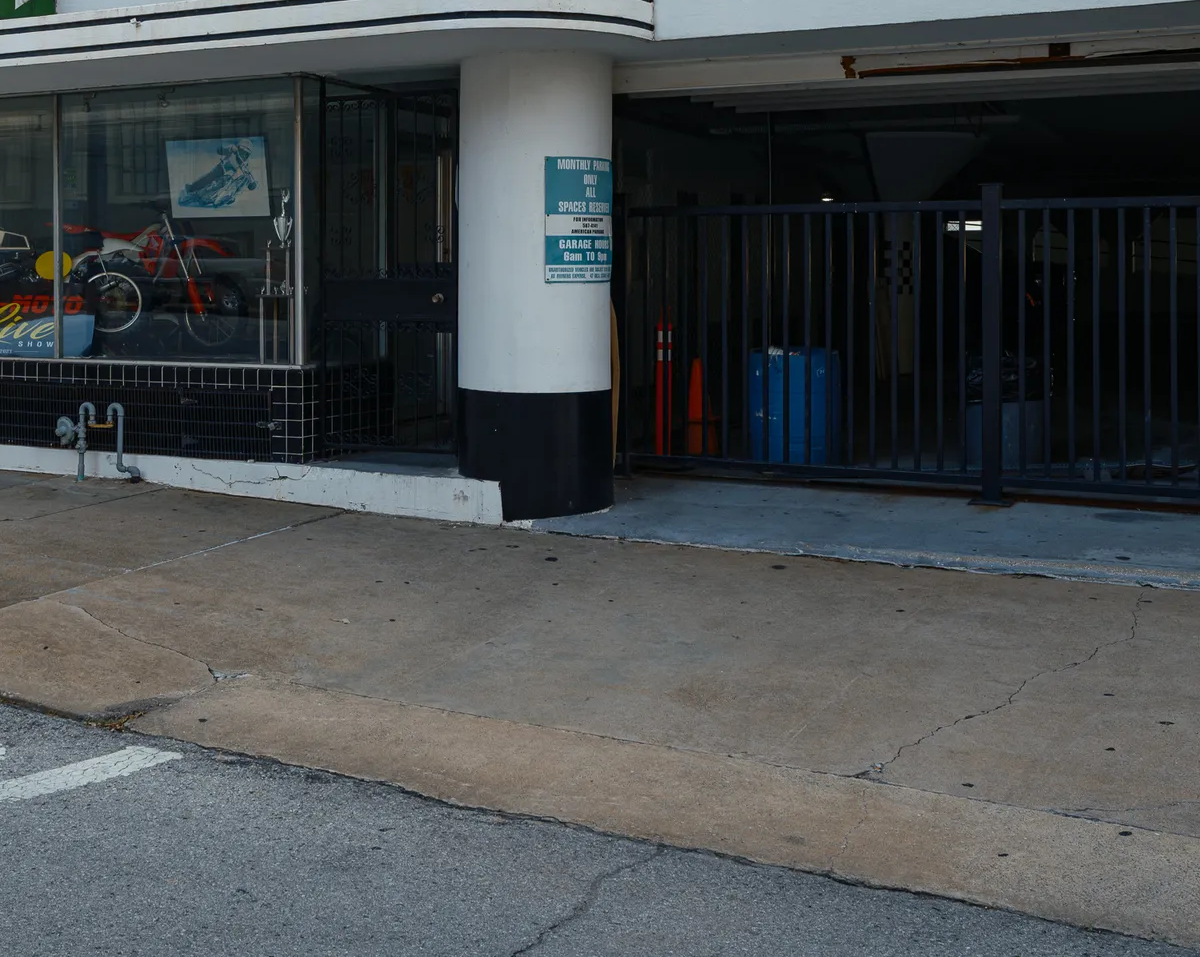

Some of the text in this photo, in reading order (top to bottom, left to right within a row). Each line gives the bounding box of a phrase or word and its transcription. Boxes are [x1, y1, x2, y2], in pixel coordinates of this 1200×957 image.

[557, 158, 591, 170] MONTHLY
[583, 174, 597, 185] ONLY
[585, 187, 596, 198] ALL
[558, 201, 586, 213] SPACES
[558, 239, 592, 249] GARAGE
[563, 251, 582, 261] 6am
[586, 251, 595, 261] TO
